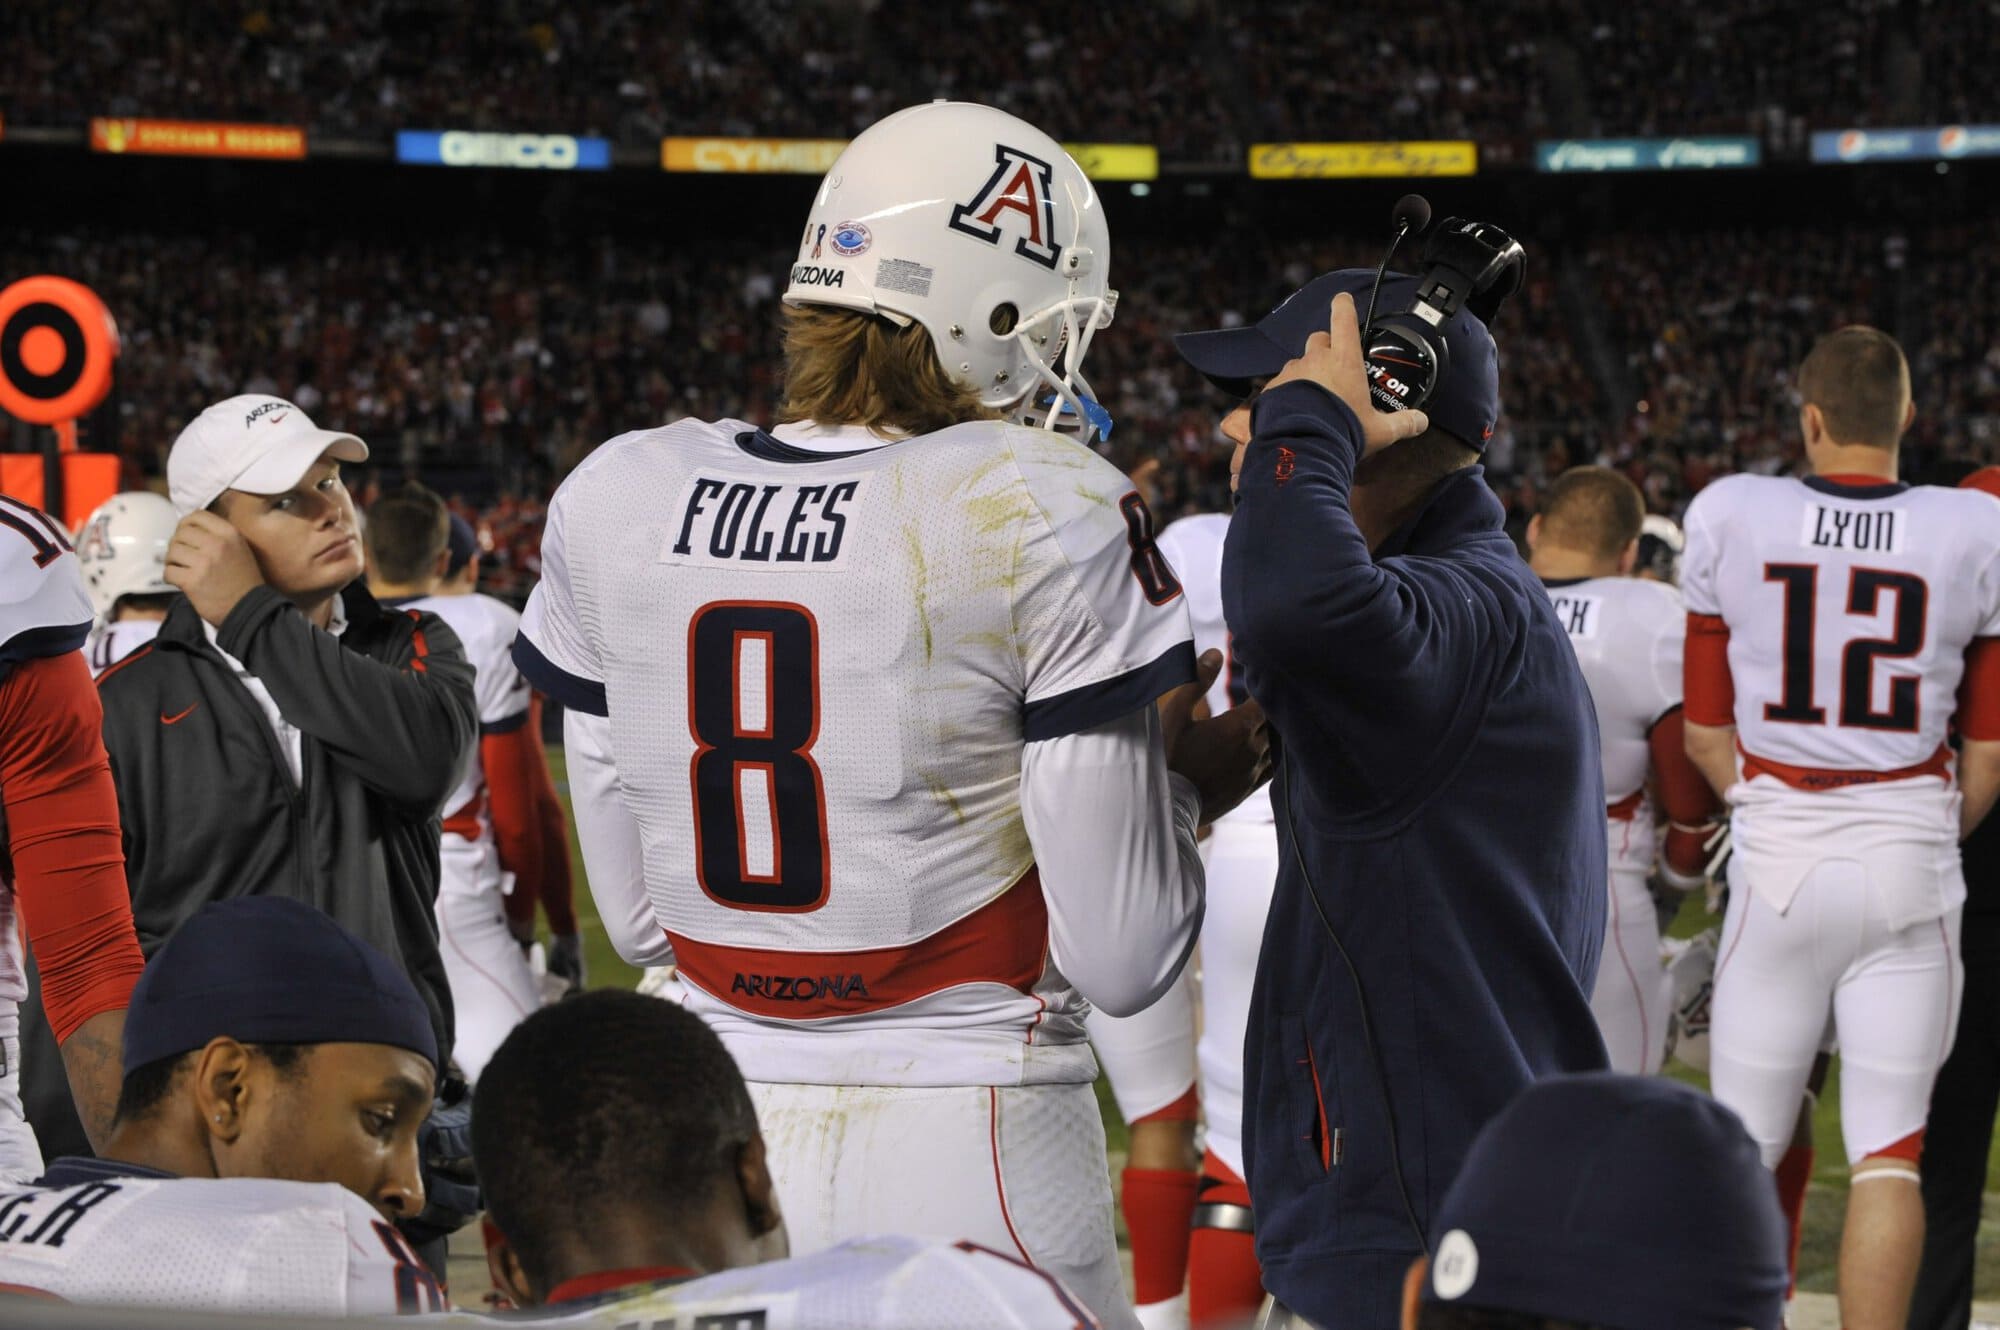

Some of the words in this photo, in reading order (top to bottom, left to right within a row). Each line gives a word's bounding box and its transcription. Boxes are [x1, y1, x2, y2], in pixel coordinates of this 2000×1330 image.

[439, 131, 578, 168] GEICO
[949, 144, 1062, 270] A
[1364, 361, 1410, 397] erizon
[672, 478, 860, 562] FOLES
[1119, 490, 1184, 606] 8
[1812, 507, 1894, 551] LYON
[1763, 562, 1929, 733] 12
[687, 600, 831, 914] 8
[732, 972, 869, 1000] ARIZONA
